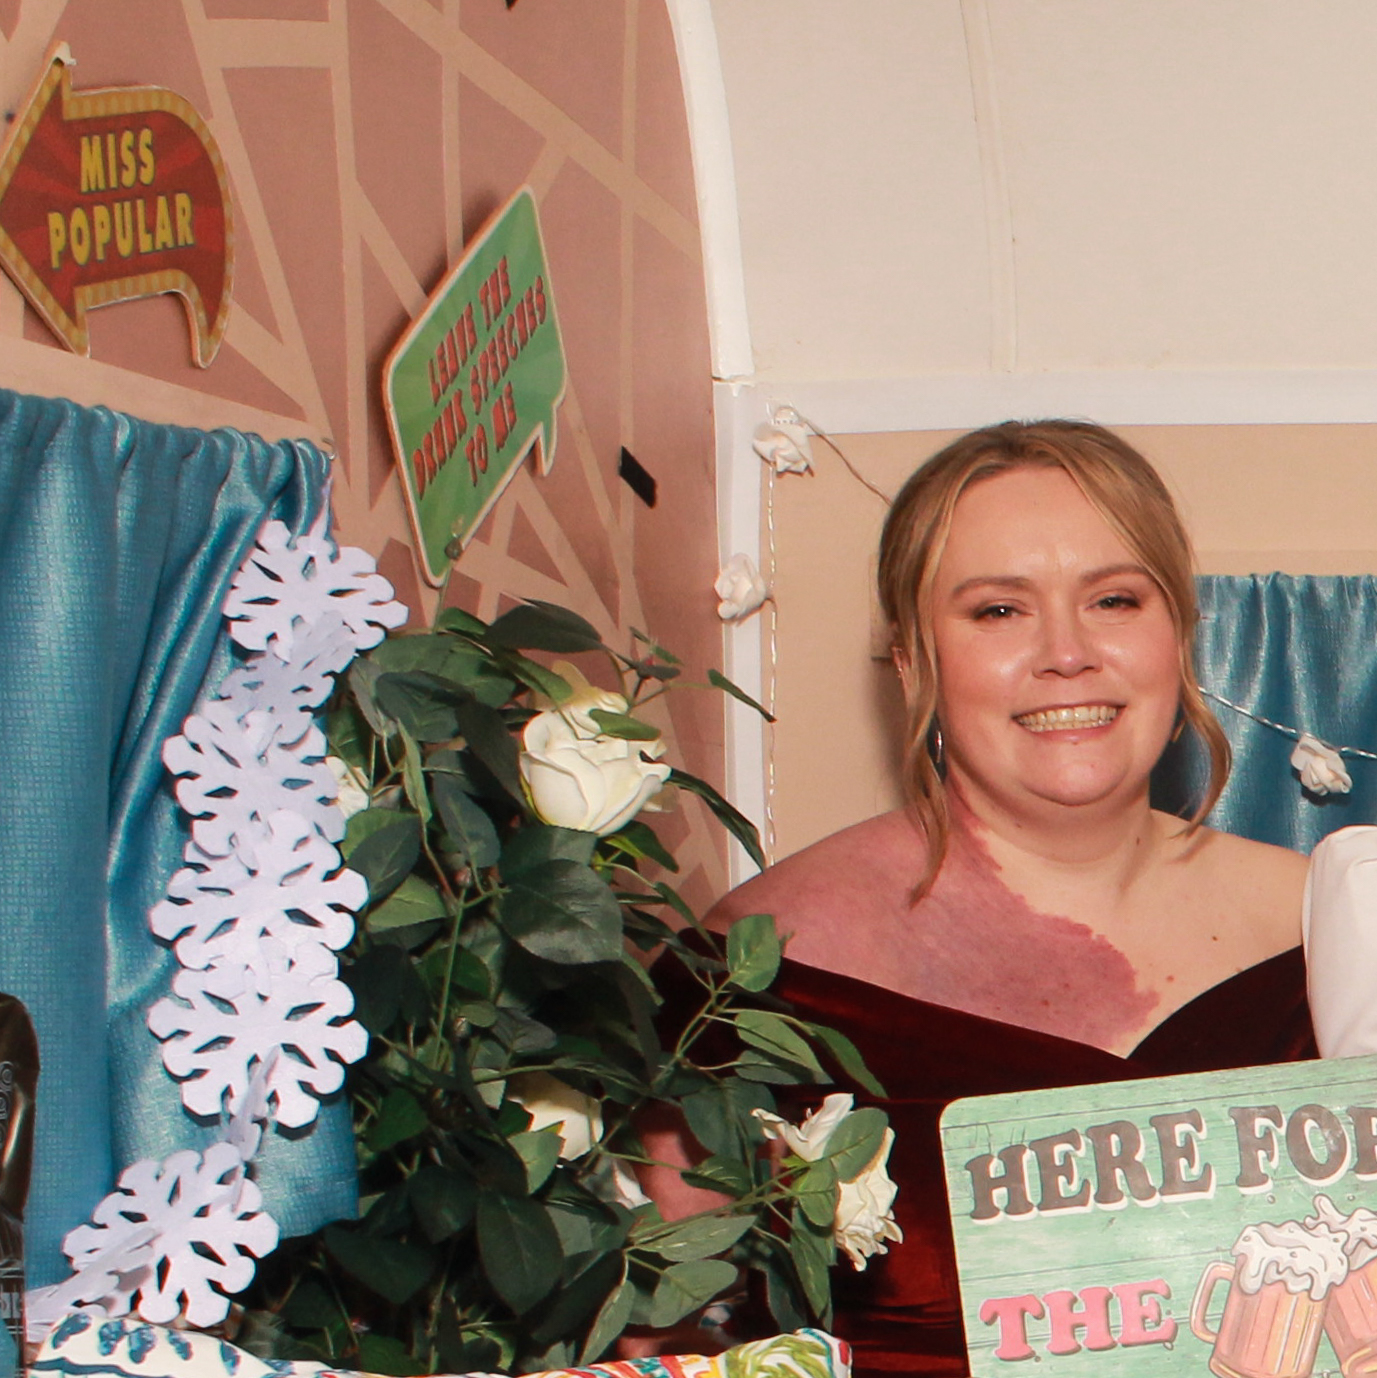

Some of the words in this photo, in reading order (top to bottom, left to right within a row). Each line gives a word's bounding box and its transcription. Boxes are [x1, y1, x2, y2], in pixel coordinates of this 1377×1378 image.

[80, 127, 155, 194] MISS
[47, 192, 195, 270] POPULAR
[428, 302, 478, 407] LEAVE
[478, 255, 511, 332] THE
[413, 389, 467, 500] DRUNK
[470, 275, 546, 416] SPEECHES
[465, 424, 488, 487] TO
[491, 381, 517, 453] ME
[964, 1109, 1216, 1226] HERE
[978, 1278, 1178, 1363] THE
